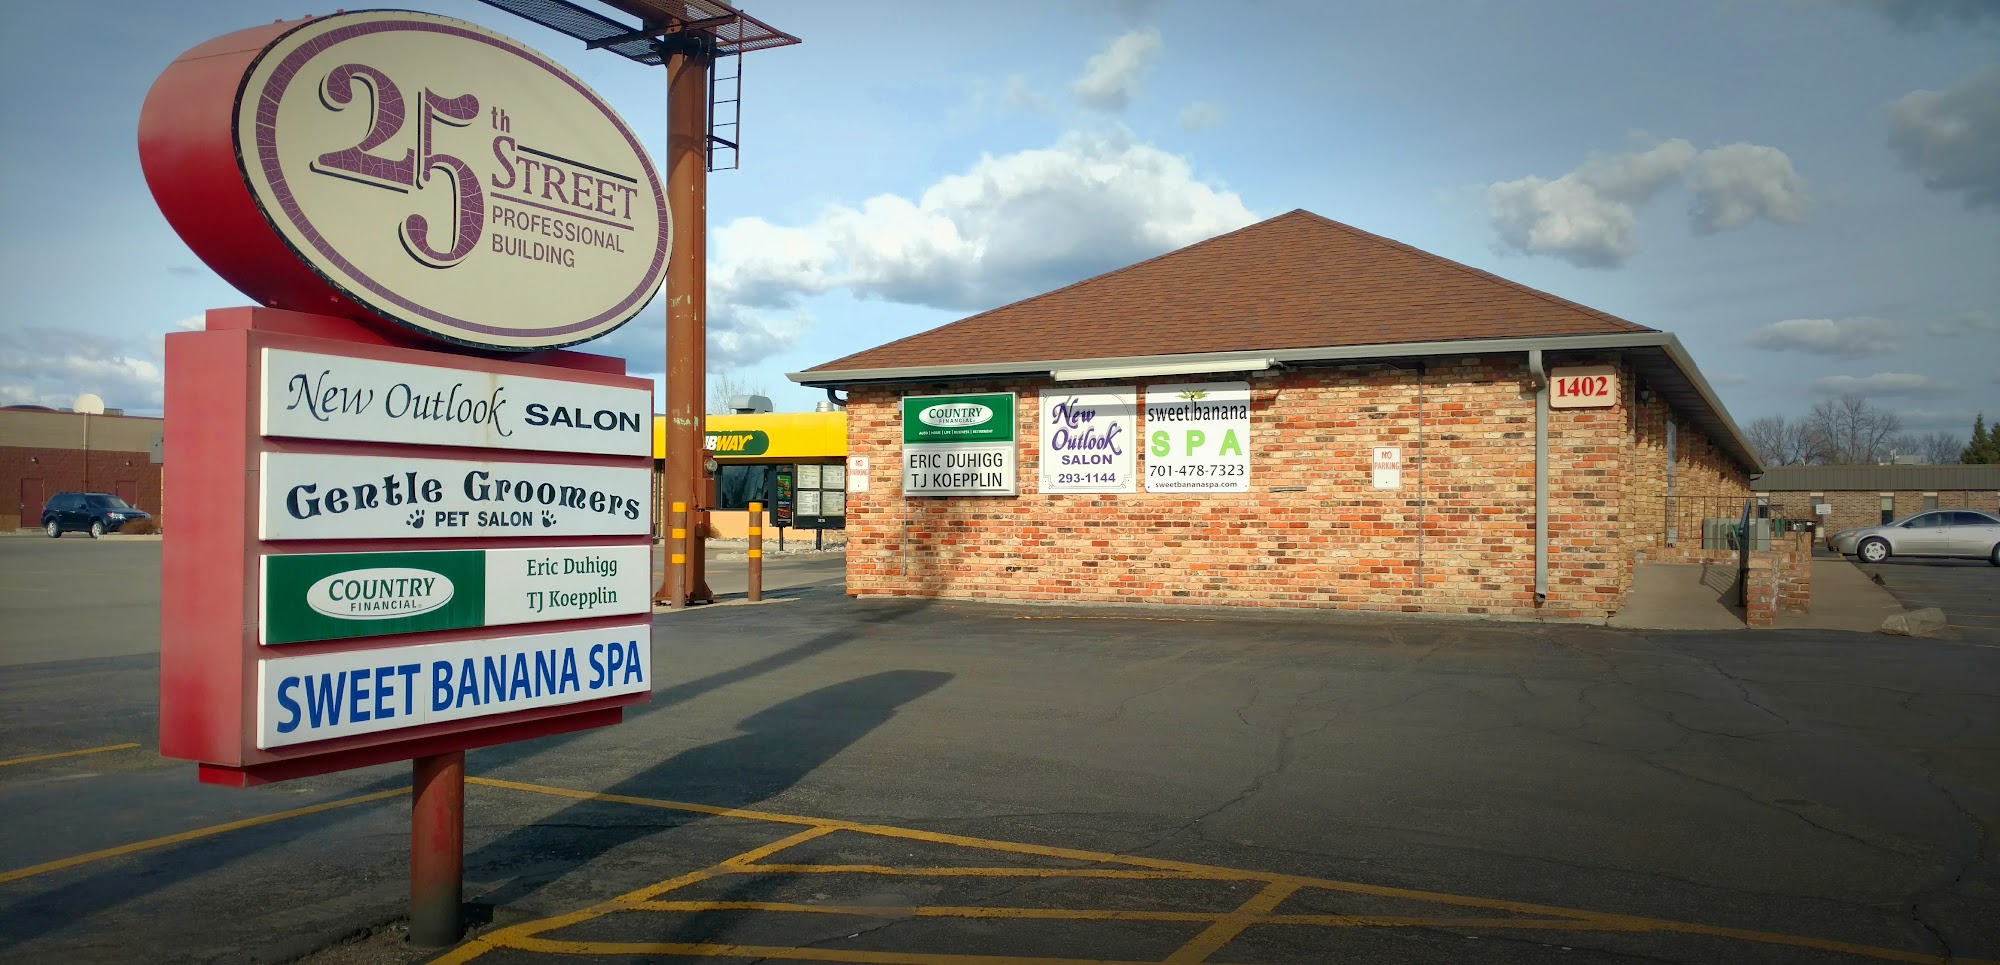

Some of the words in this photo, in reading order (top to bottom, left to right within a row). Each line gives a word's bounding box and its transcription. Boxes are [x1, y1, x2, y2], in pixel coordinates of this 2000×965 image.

[491, 135, 638, 220] STREET
[492, 205, 624, 253] PROFESSIONAL
[492, 233, 575, 268] BUILDING
[1557, 376, 1608, 398] 1402
[287, 370, 374, 422] New
[385, 383, 513, 437] Outlook
[524, 403, 641, 433] SALON
[928, 407, 983, 419] COUNTRY
[1052, 398, 1096, 429] New
[910, 454, 941, 469] ERIC
[947, 453, 1003, 468] DUHIGG
[1062, 454, 1113, 465] SALON
[1381, 450, 1393, 460] NO
[1150, 464, 1245, 477] 701-478-7323
[1374, 462, 1400, 470] PARKING
[911, 473, 927, 488] TJ
[933, 472, 1003, 488] KOEPPLIN
[1058, 473, 1116, 484] 293-1144
[1155, 480, 1238, 489] sweetbananaspa.com
[286, 471, 443, 520] Gentle
[463, 470, 641, 521] Groomers
[435, 511, 468, 527] PET
[477, 511, 533, 527] SALON
[526, 558, 558, 577] Eric
[563, 556, 618, 577] Duhigg
[328, 577, 436, 601] COUNTRY
[350, 600, 417, 612] FINANCIAL
[527, 592, 543, 612] TJ
[549, 587, 618, 611] Koepplin
[277, 663, 421, 734] SWEET
[432, 646, 580, 712] BANANA
[588, 640, 643, 690] SPA
